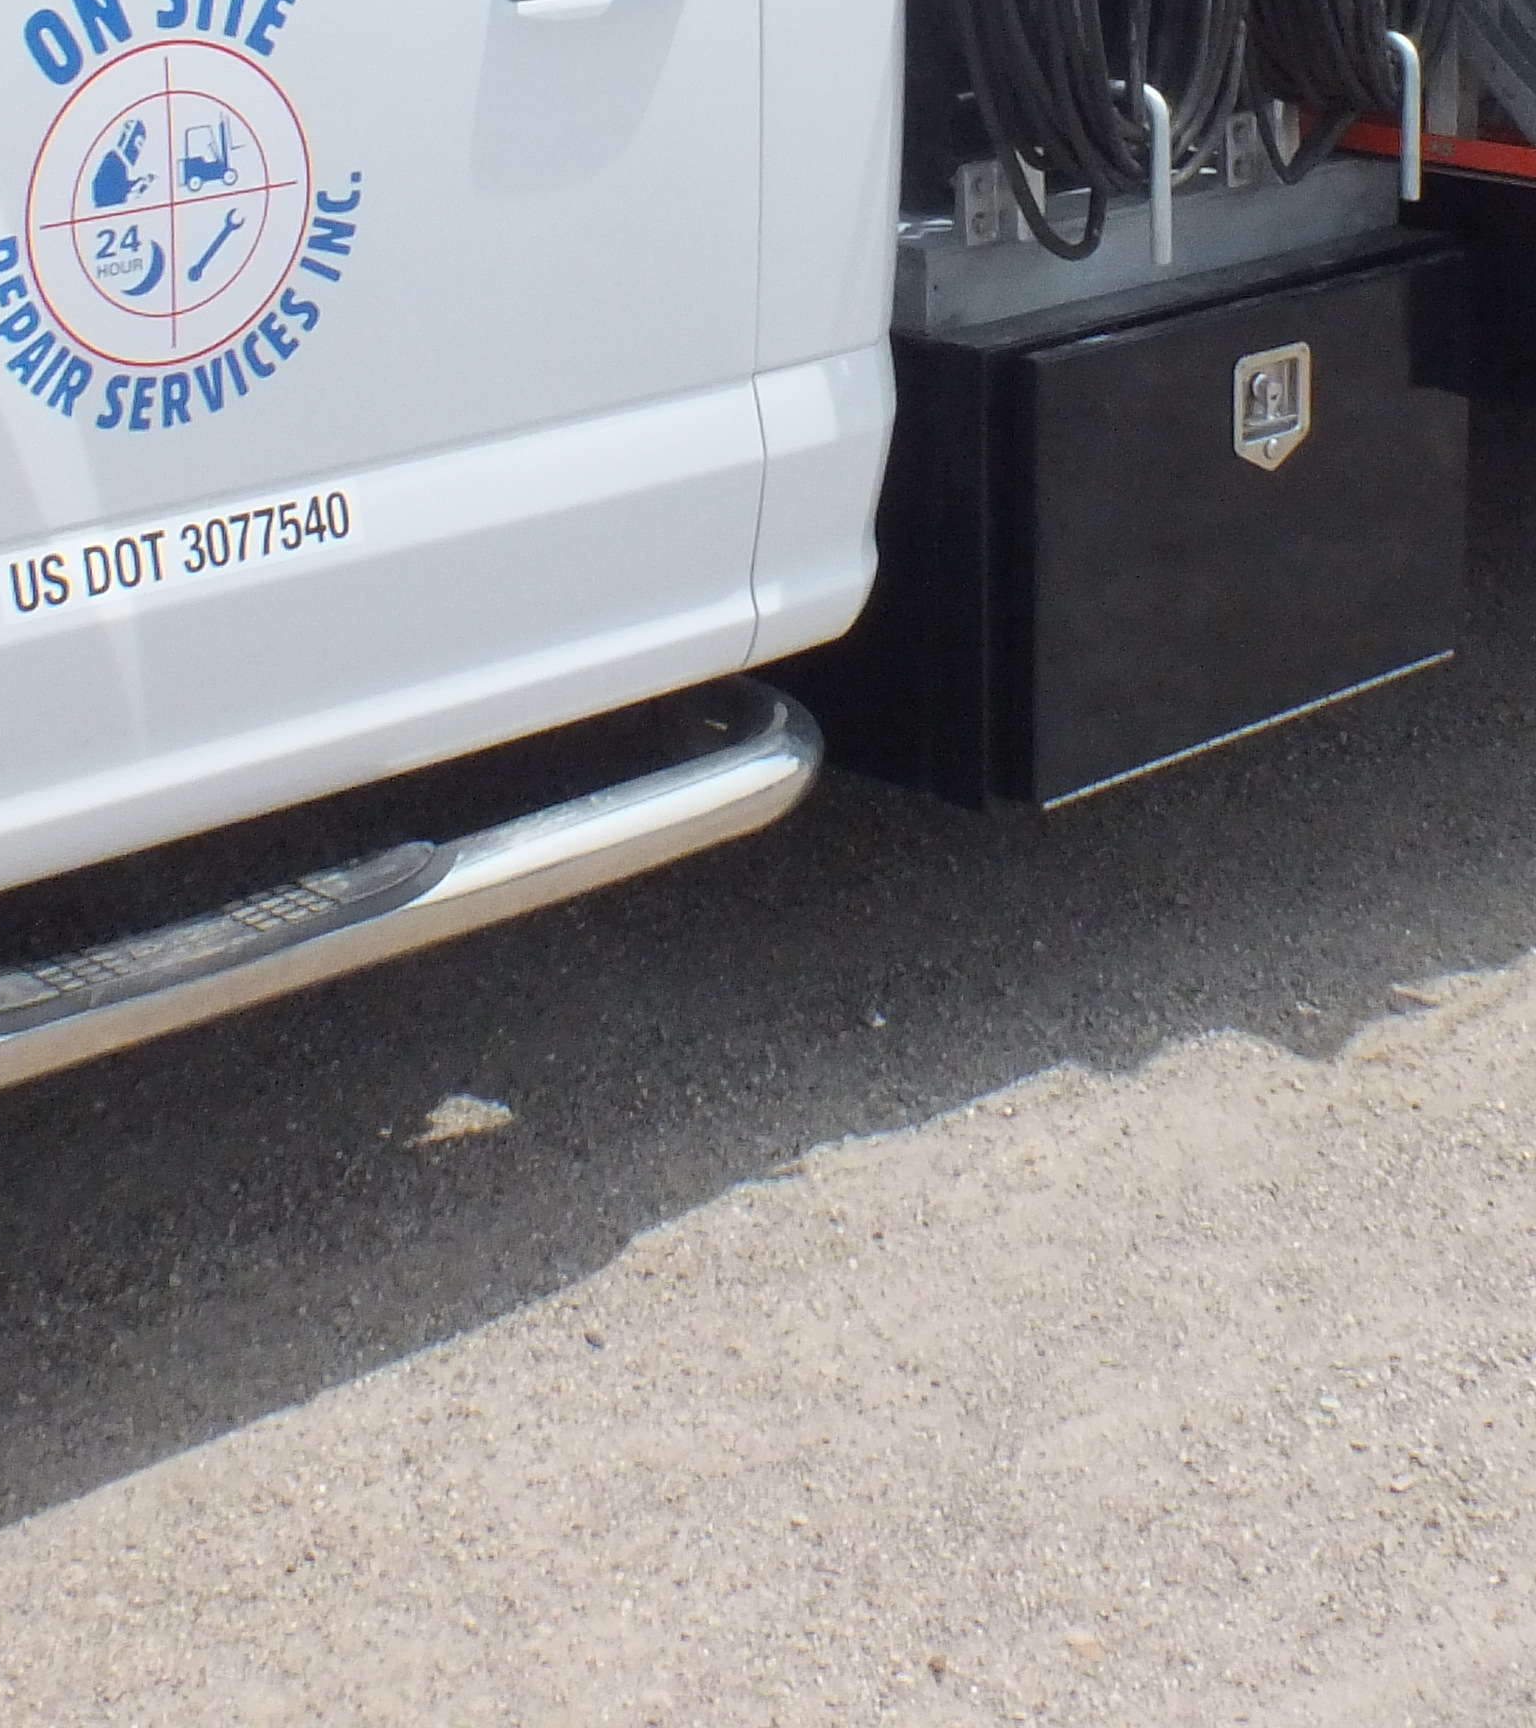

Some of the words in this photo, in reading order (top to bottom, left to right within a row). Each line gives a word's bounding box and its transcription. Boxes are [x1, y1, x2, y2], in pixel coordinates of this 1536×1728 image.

[96, 225, 141, 259] 24
[97, 258, 143, 278] HOUR
[95, 288, 323, 431] SERVICES
[301, 170, 363, 283] INC.
[9, 553, 70, 614] US
[84, 531, 168, 598] DOT
[181, 489, 351, 573] 3077540
